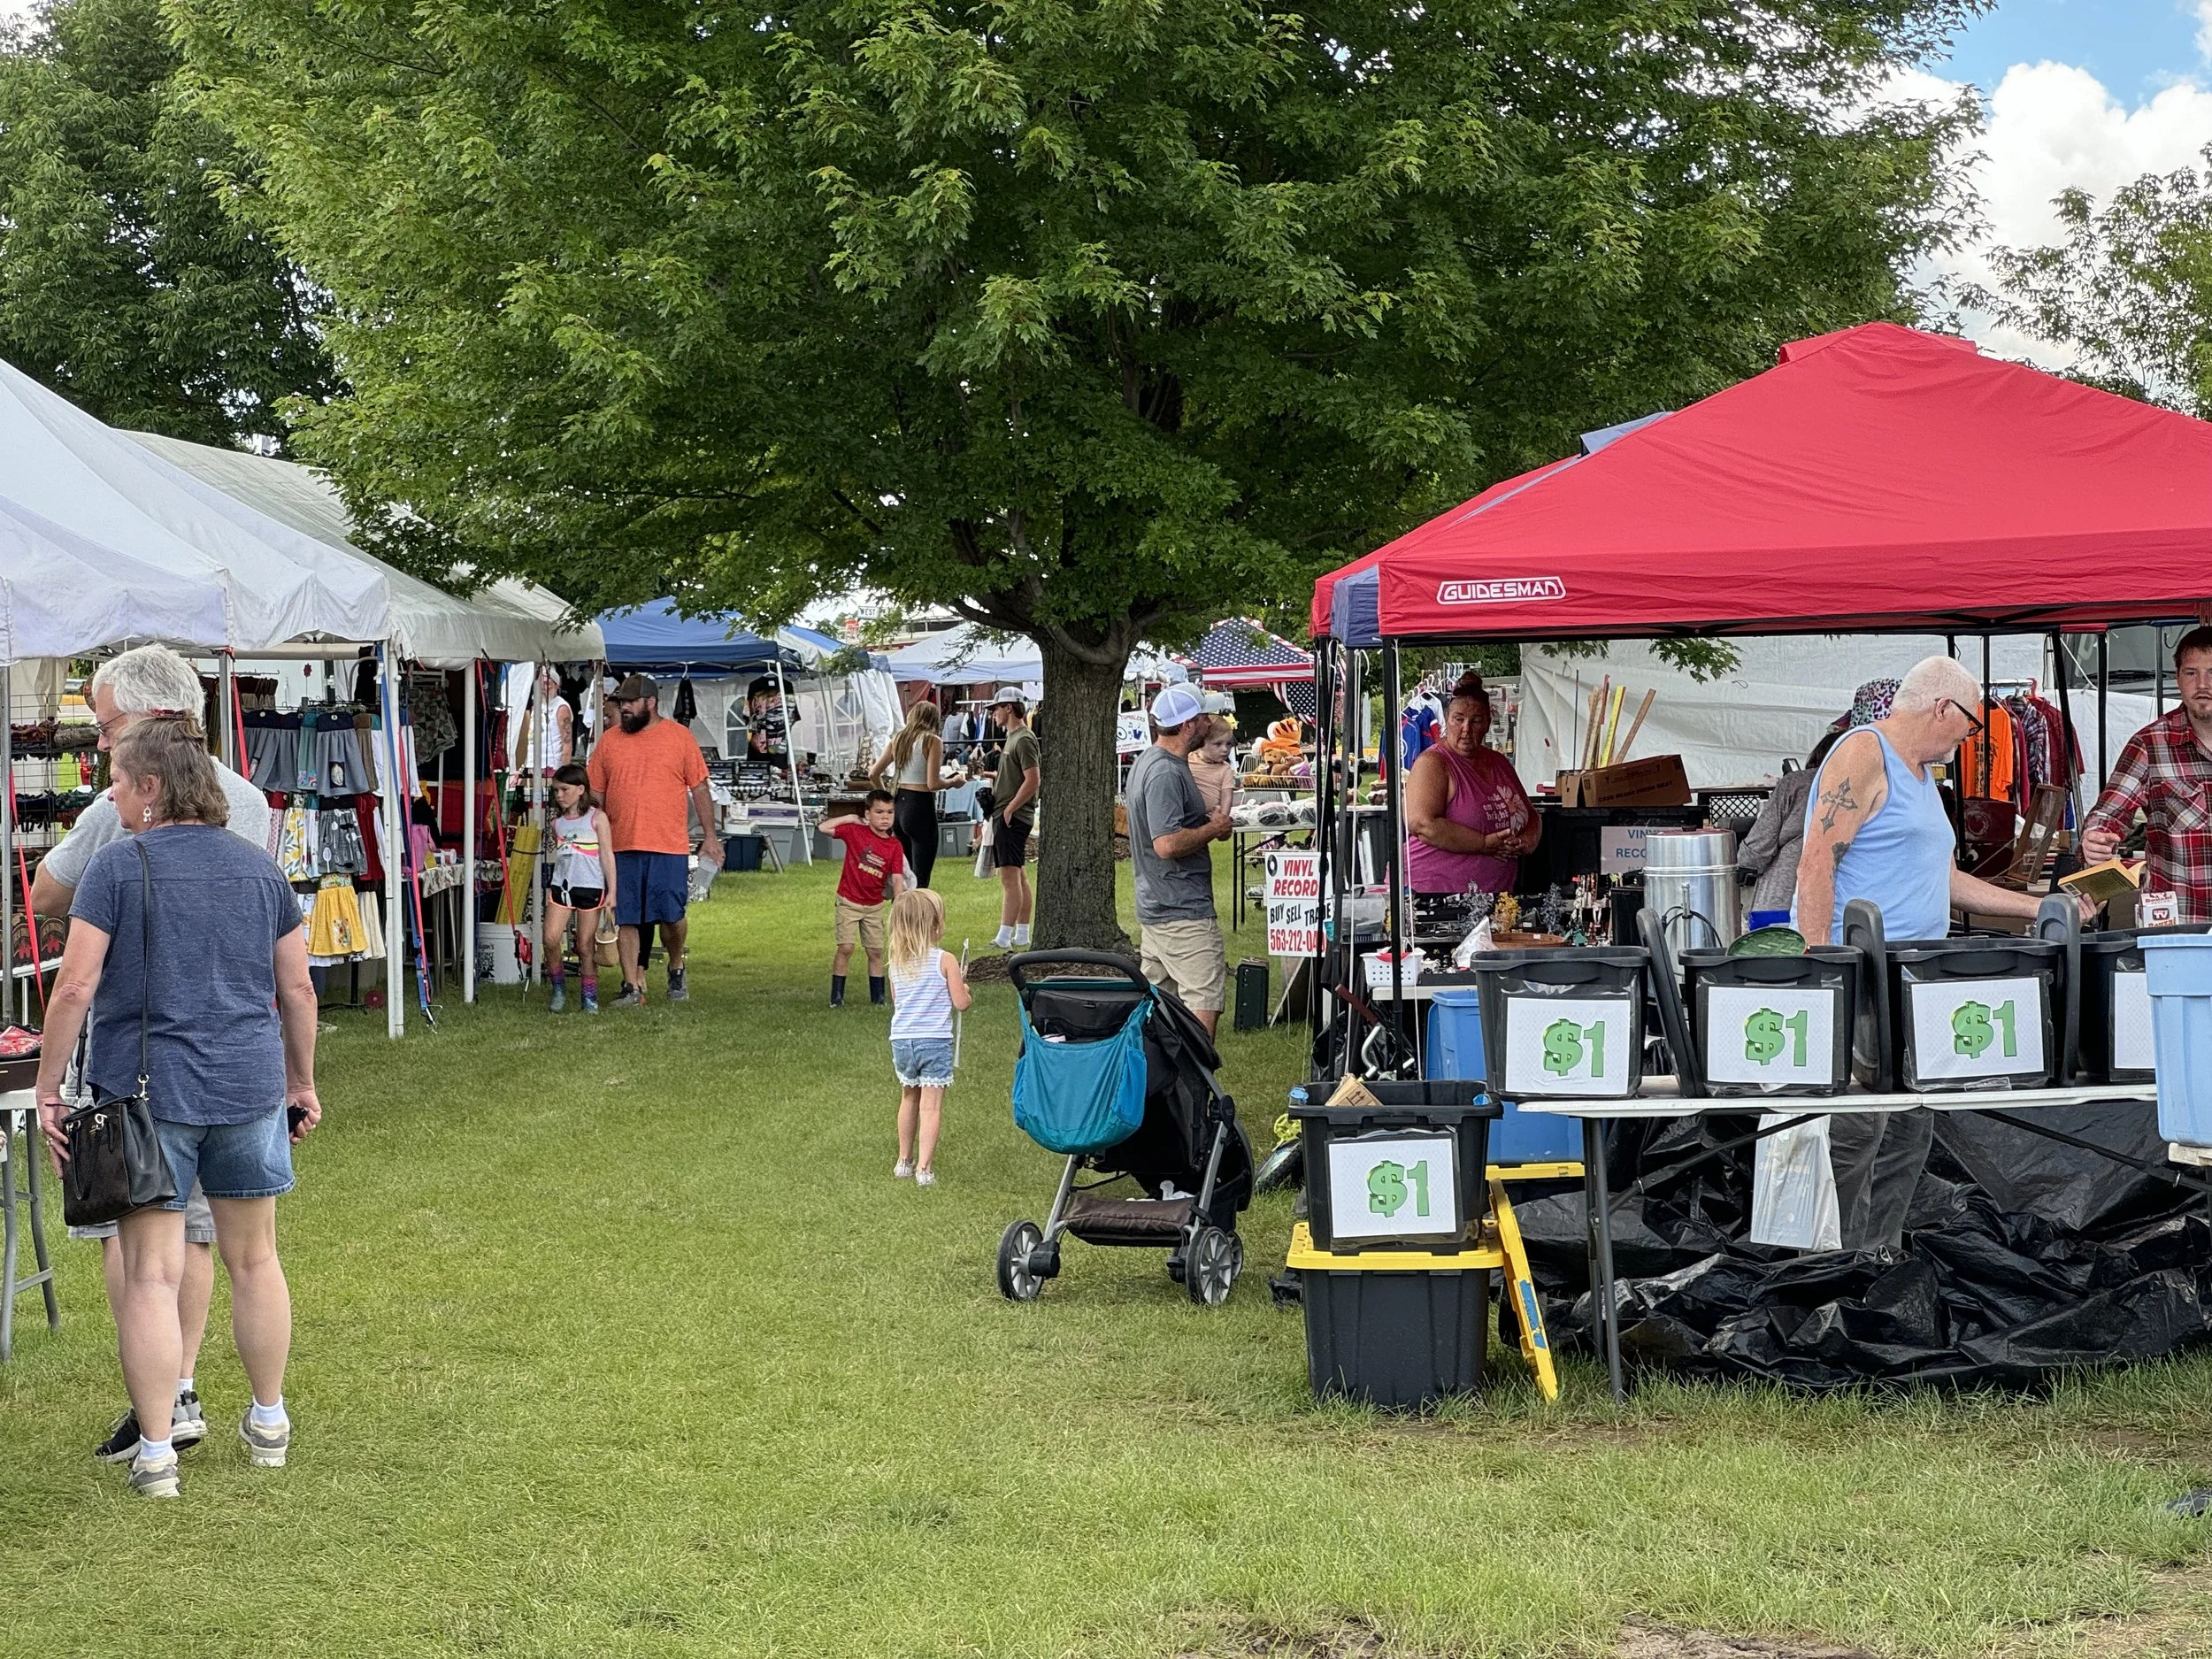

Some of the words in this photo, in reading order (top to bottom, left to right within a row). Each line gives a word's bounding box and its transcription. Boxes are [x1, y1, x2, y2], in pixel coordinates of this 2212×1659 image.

[1443, 580, 1559, 601] GUIDESMAN
[858, 607, 876, 616] WEST
[1486, 810, 1509, 822] bright
[1616, 848, 1647, 858] RECO
[1284, 859, 1314, 877] VINYL
[1270, 903, 1285, 925] BUY
[1286, 903, 1302, 925] SELL
[1744, 1007, 1808, 1067] $1
[1950, 1000, 2017, 1060] $1
[1542, 1018, 1606, 1078] $1
[1366, 1159, 1430, 1218] $1
